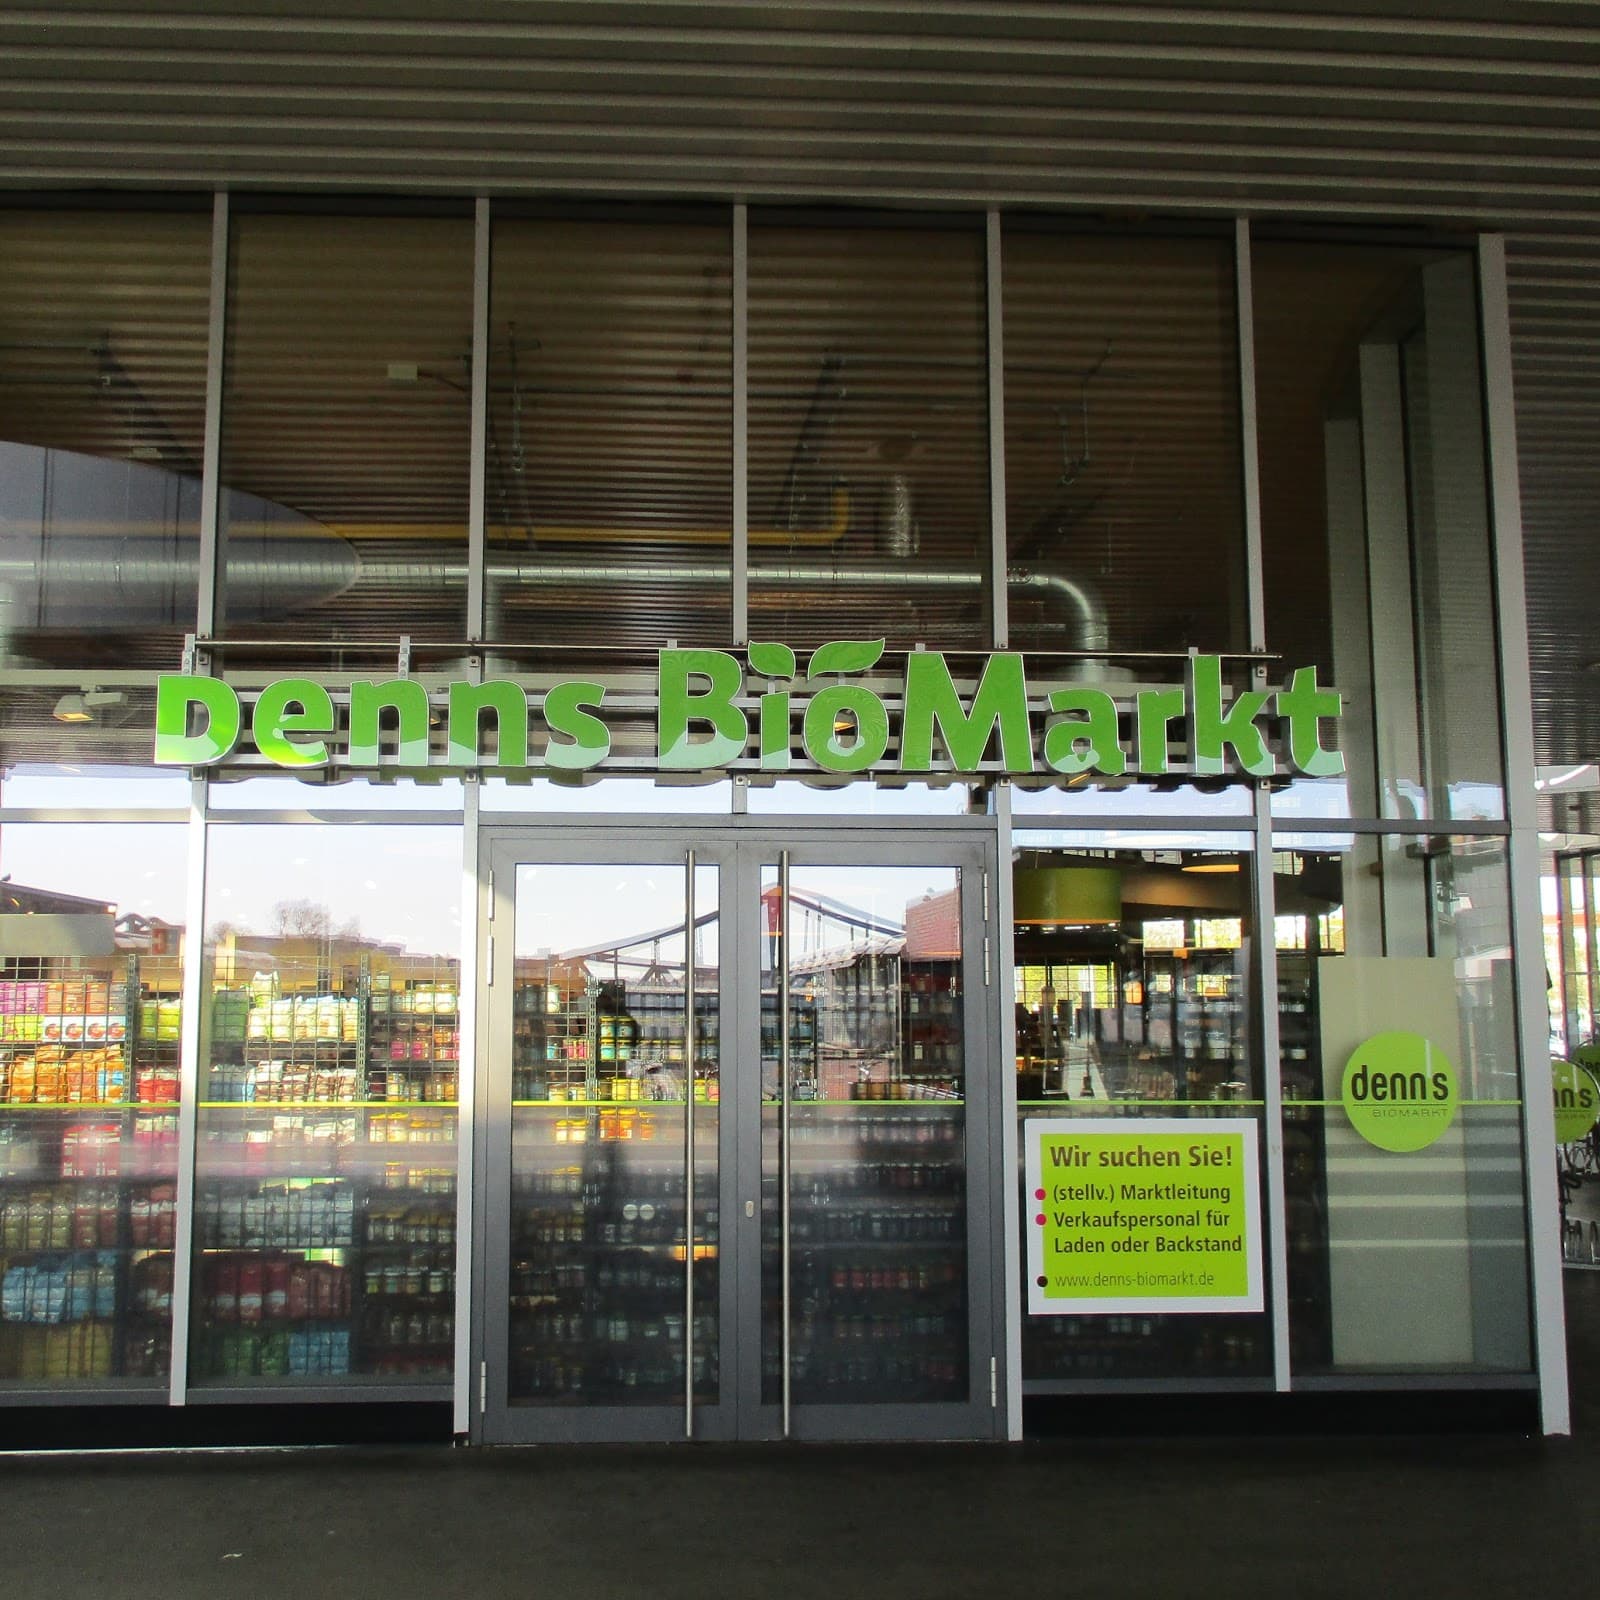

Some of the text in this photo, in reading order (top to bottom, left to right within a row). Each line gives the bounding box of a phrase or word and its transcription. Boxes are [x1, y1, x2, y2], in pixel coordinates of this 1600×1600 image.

[154, 638, 1346, 776] Denns BioMarkt
[1050, 1145, 1233, 1167] Wir suchen Sie!
[1053, 1183, 1231, 1204] (stellv.) Marktleitung
[1054, 1209, 1230, 1231] Verkaufspersonal für
[1054, 1235, 1242, 1253] Laden oder Backstand
[1055, 1271, 1215, 1287] www.denns-biomarkt.de
